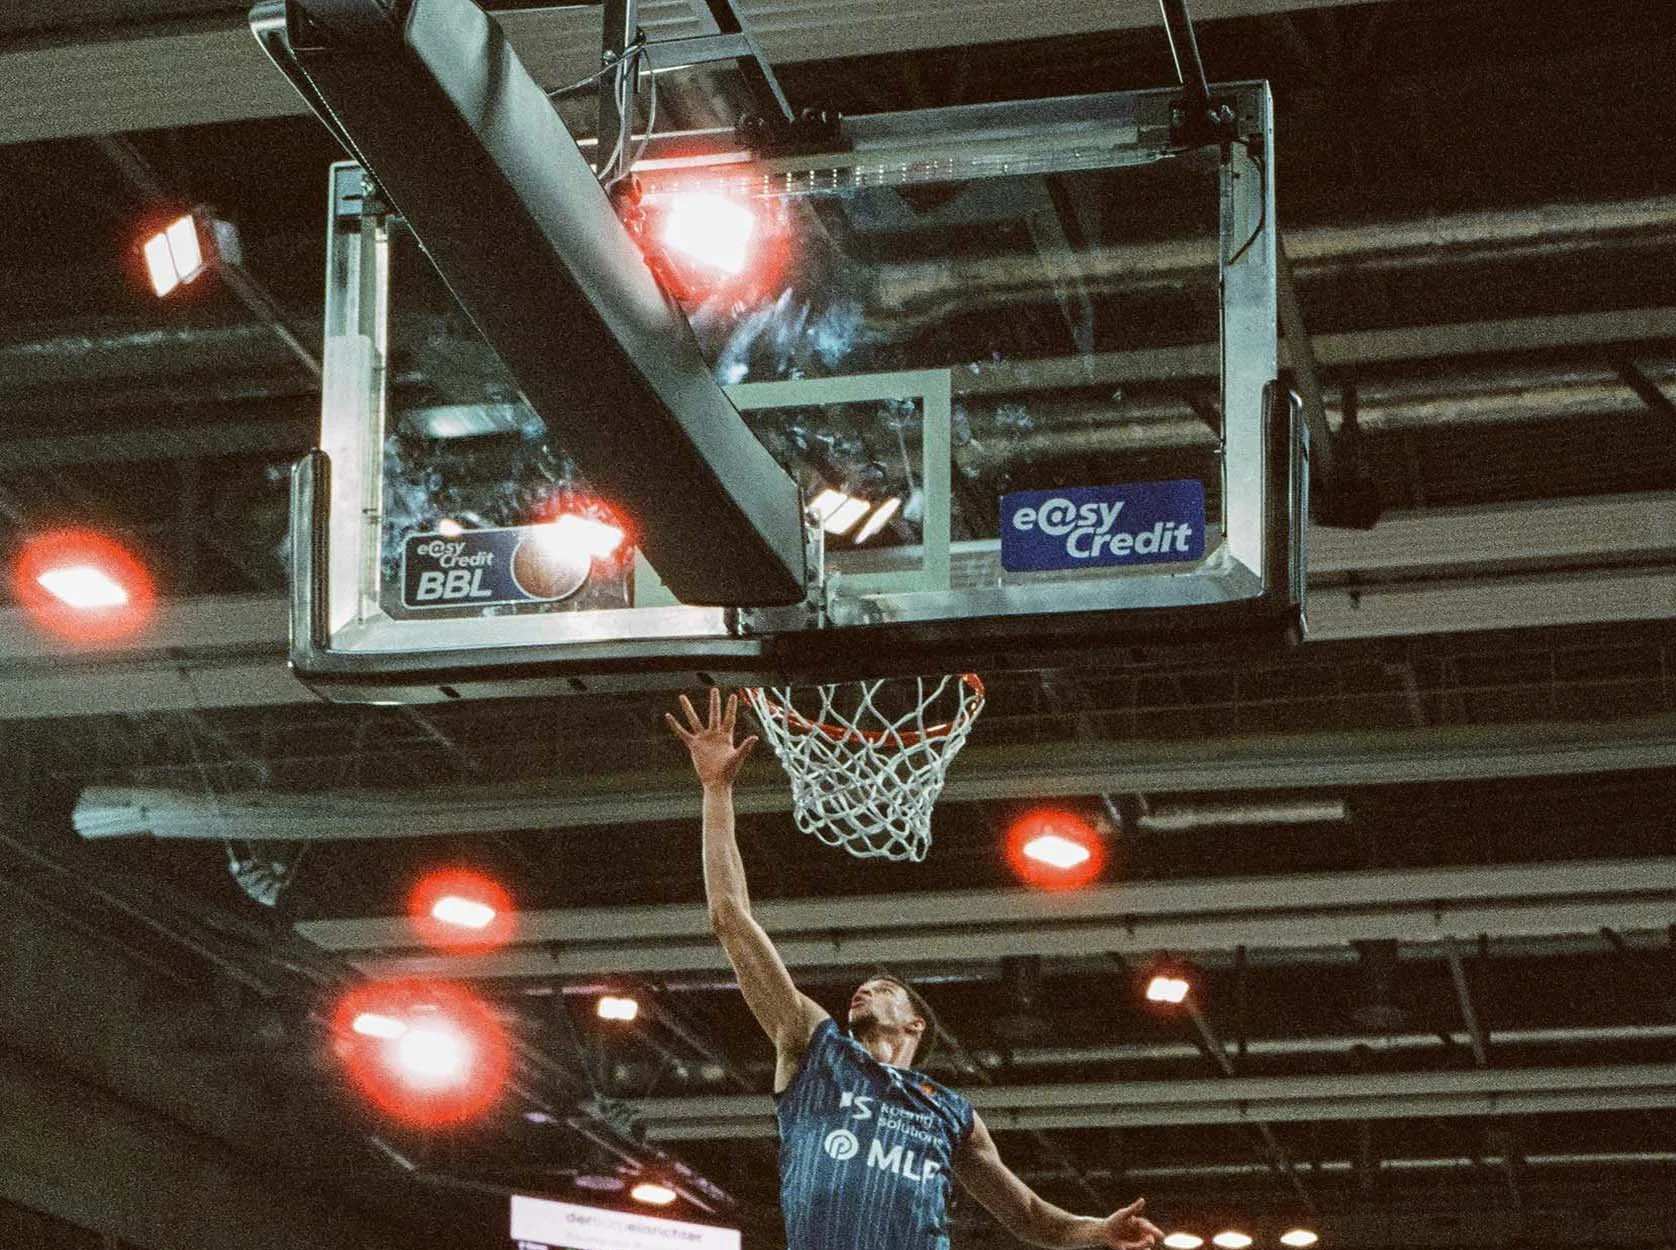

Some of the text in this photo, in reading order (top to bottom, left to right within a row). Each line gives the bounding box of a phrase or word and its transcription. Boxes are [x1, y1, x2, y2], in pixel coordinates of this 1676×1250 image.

[1012, 498, 1124, 535] e@sy
[1066, 521, 1193, 558] Credit
[440, 552, 495, 568] Credit
[416, 570, 492, 601] BBL
